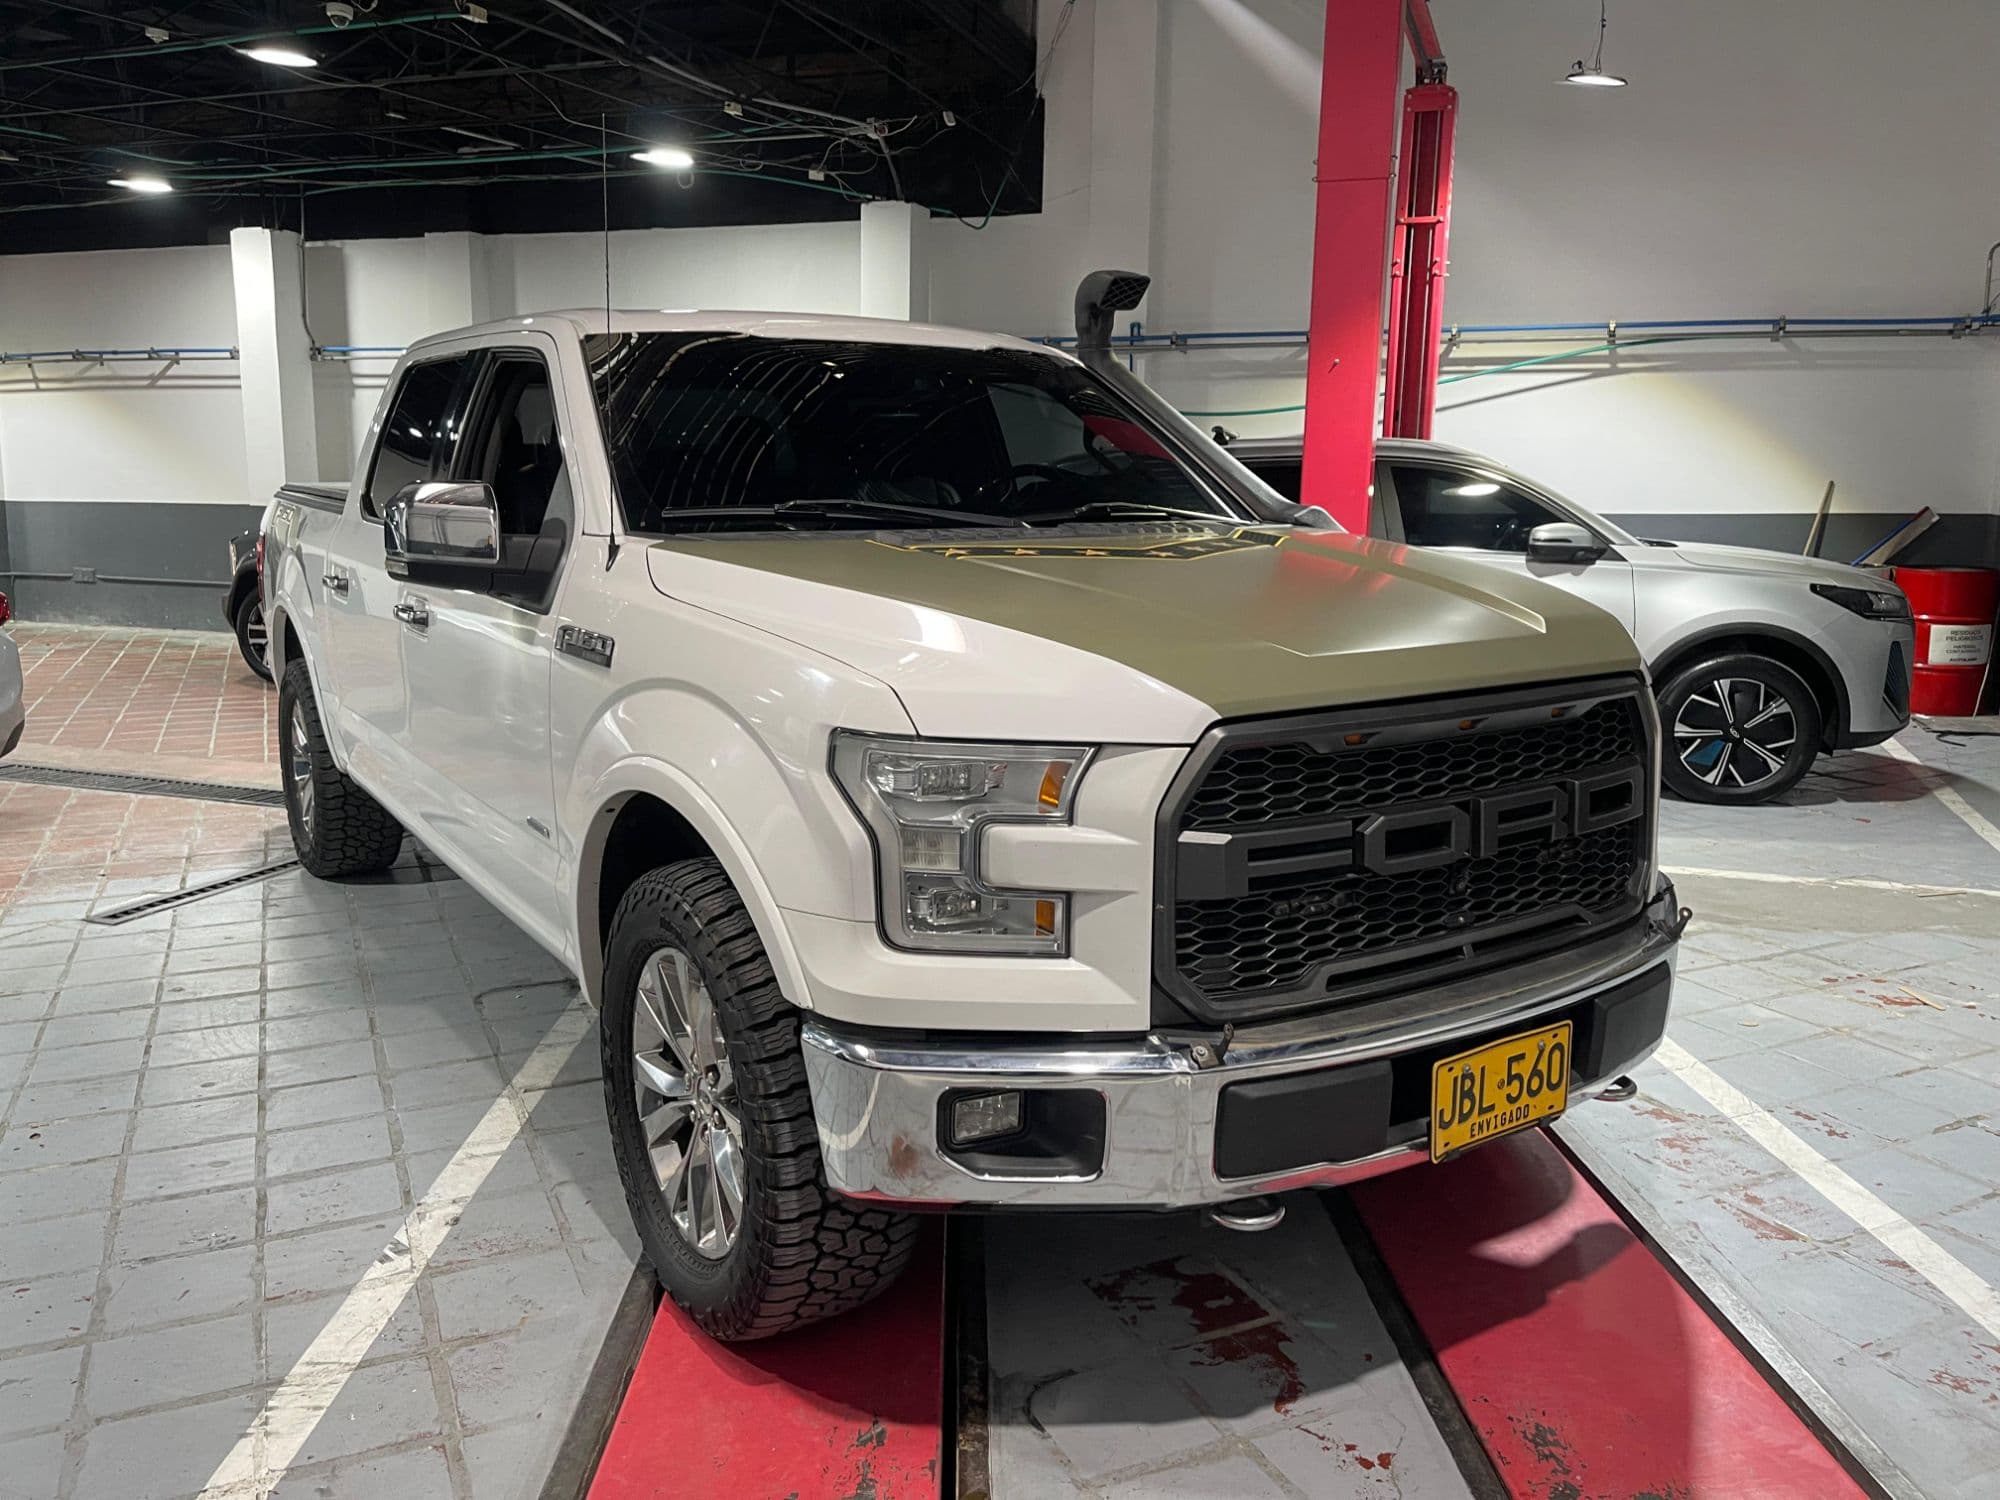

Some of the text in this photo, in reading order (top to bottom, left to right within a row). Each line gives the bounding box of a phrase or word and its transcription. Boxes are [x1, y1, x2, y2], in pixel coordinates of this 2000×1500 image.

[1177, 765, 1645, 900] FORD
[1438, 1042, 1565, 1130] JBL 560
[1469, 1104, 1530, 1138] ENVIGADO
